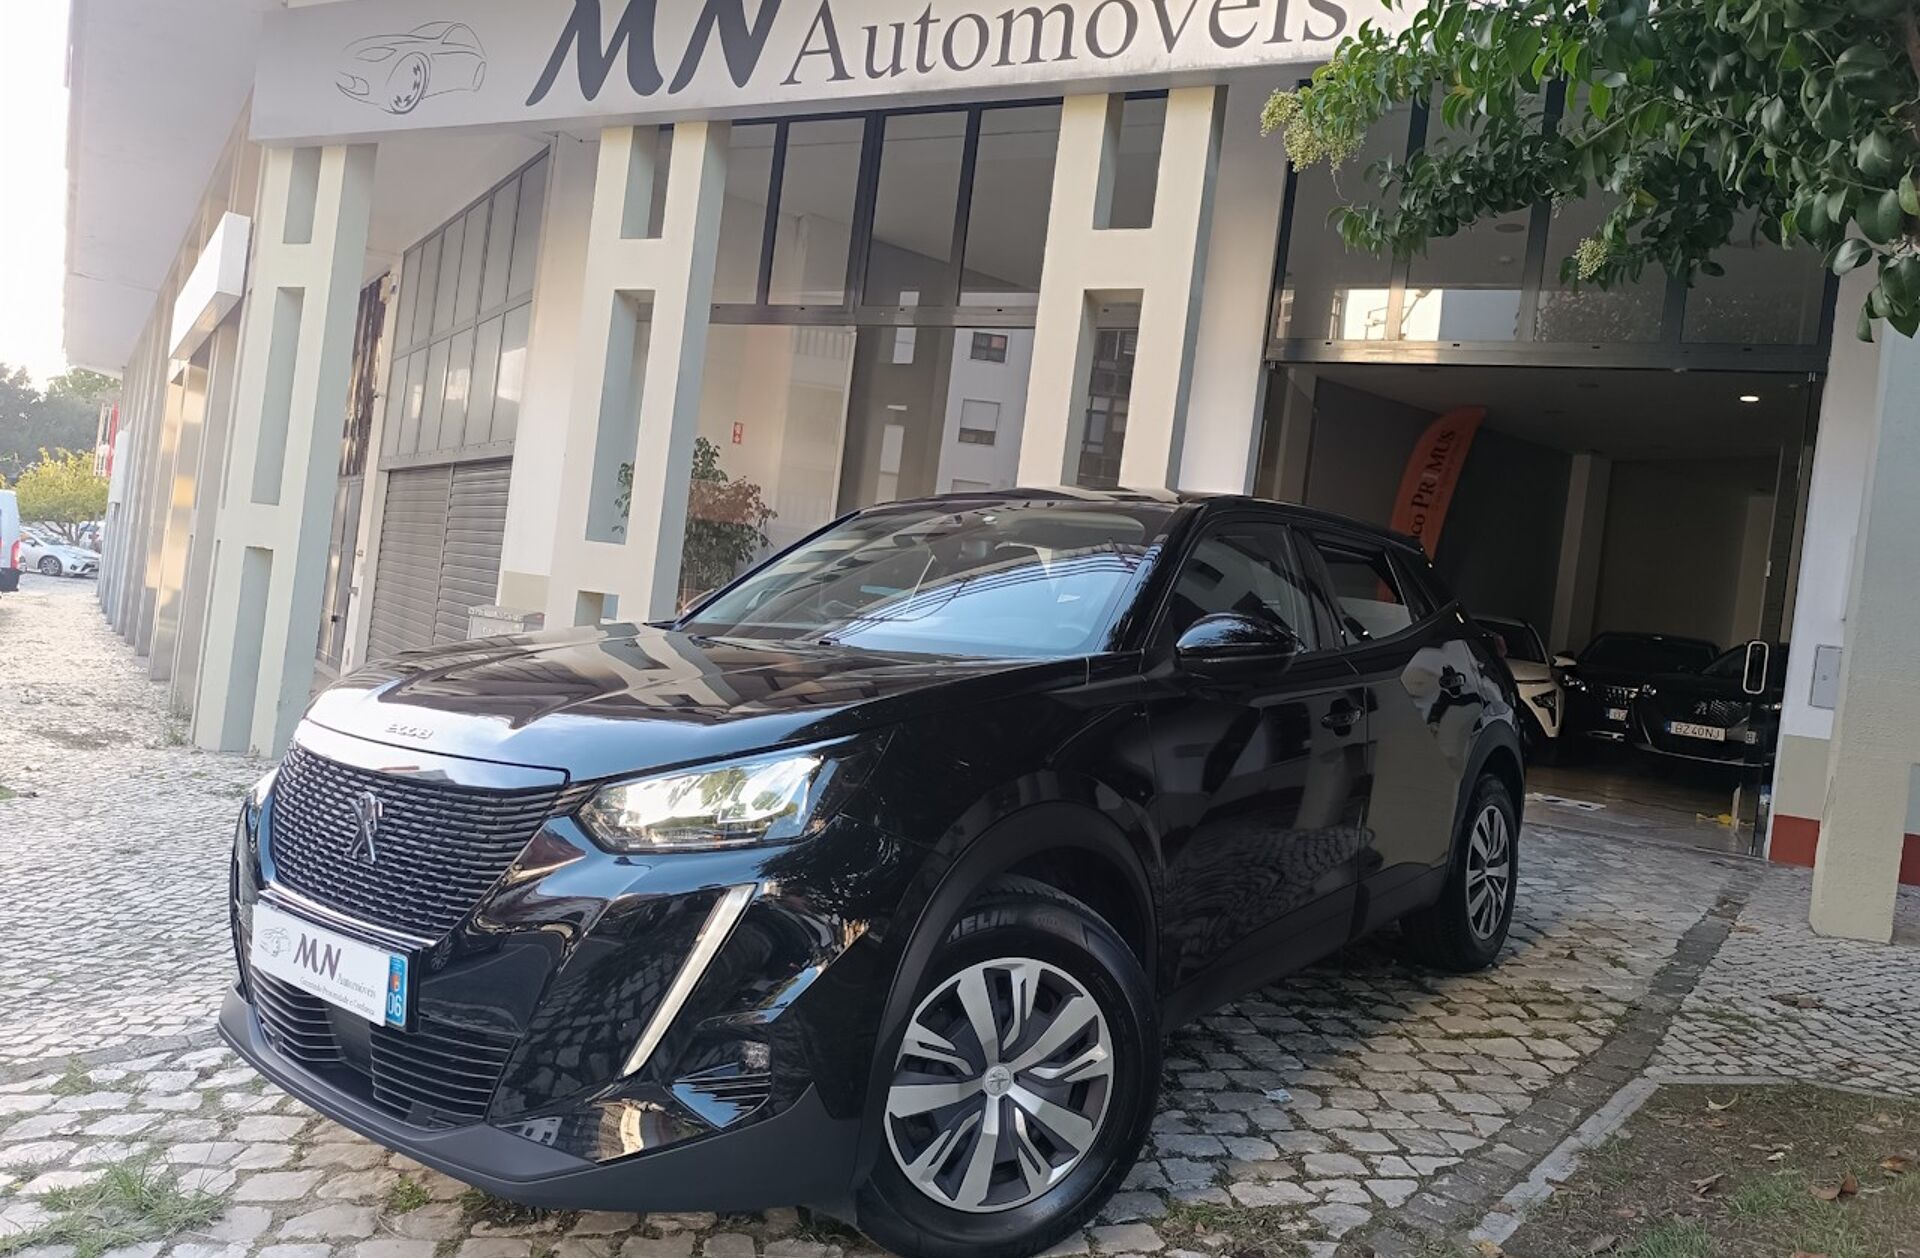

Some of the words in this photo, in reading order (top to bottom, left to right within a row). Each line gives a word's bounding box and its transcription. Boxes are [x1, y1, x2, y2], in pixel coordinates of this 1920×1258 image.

[525, 0, 782, 106] MN
[1675, 723, 1721, 740] BZ40NJ
[294, 933, 342, 980] MN
[388, 992, 402, 1017] 06
